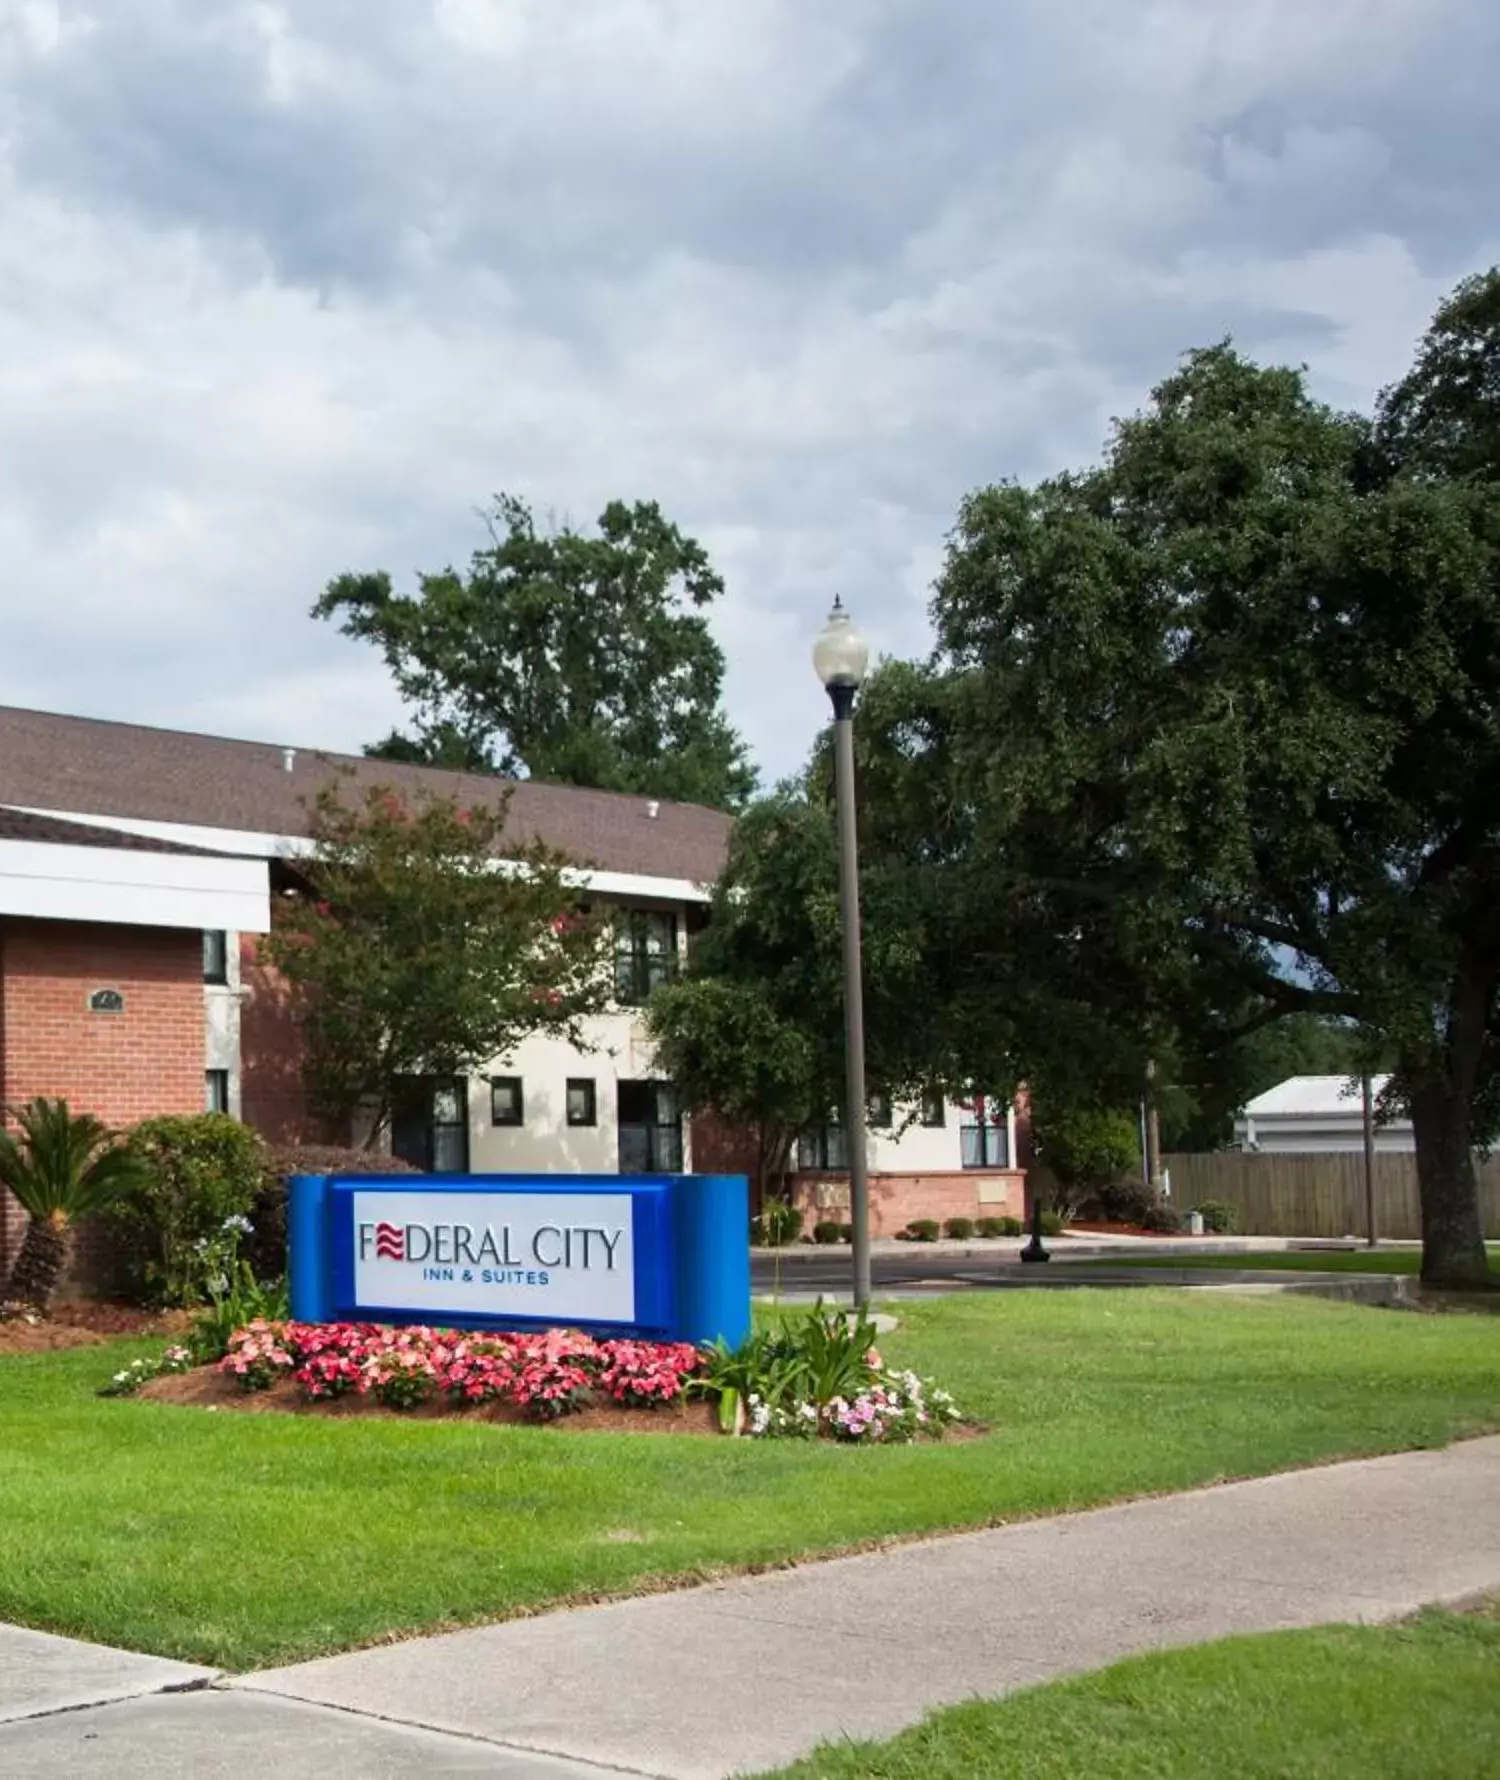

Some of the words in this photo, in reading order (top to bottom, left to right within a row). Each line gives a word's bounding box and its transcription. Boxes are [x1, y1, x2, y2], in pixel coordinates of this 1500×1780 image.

[533, 1225, 624, 1271] CITY
[423, 1268, 455, 1282] INN
[462, 1269, 474, 1283] &
[481, 1270, 550, 1286] SUITES
